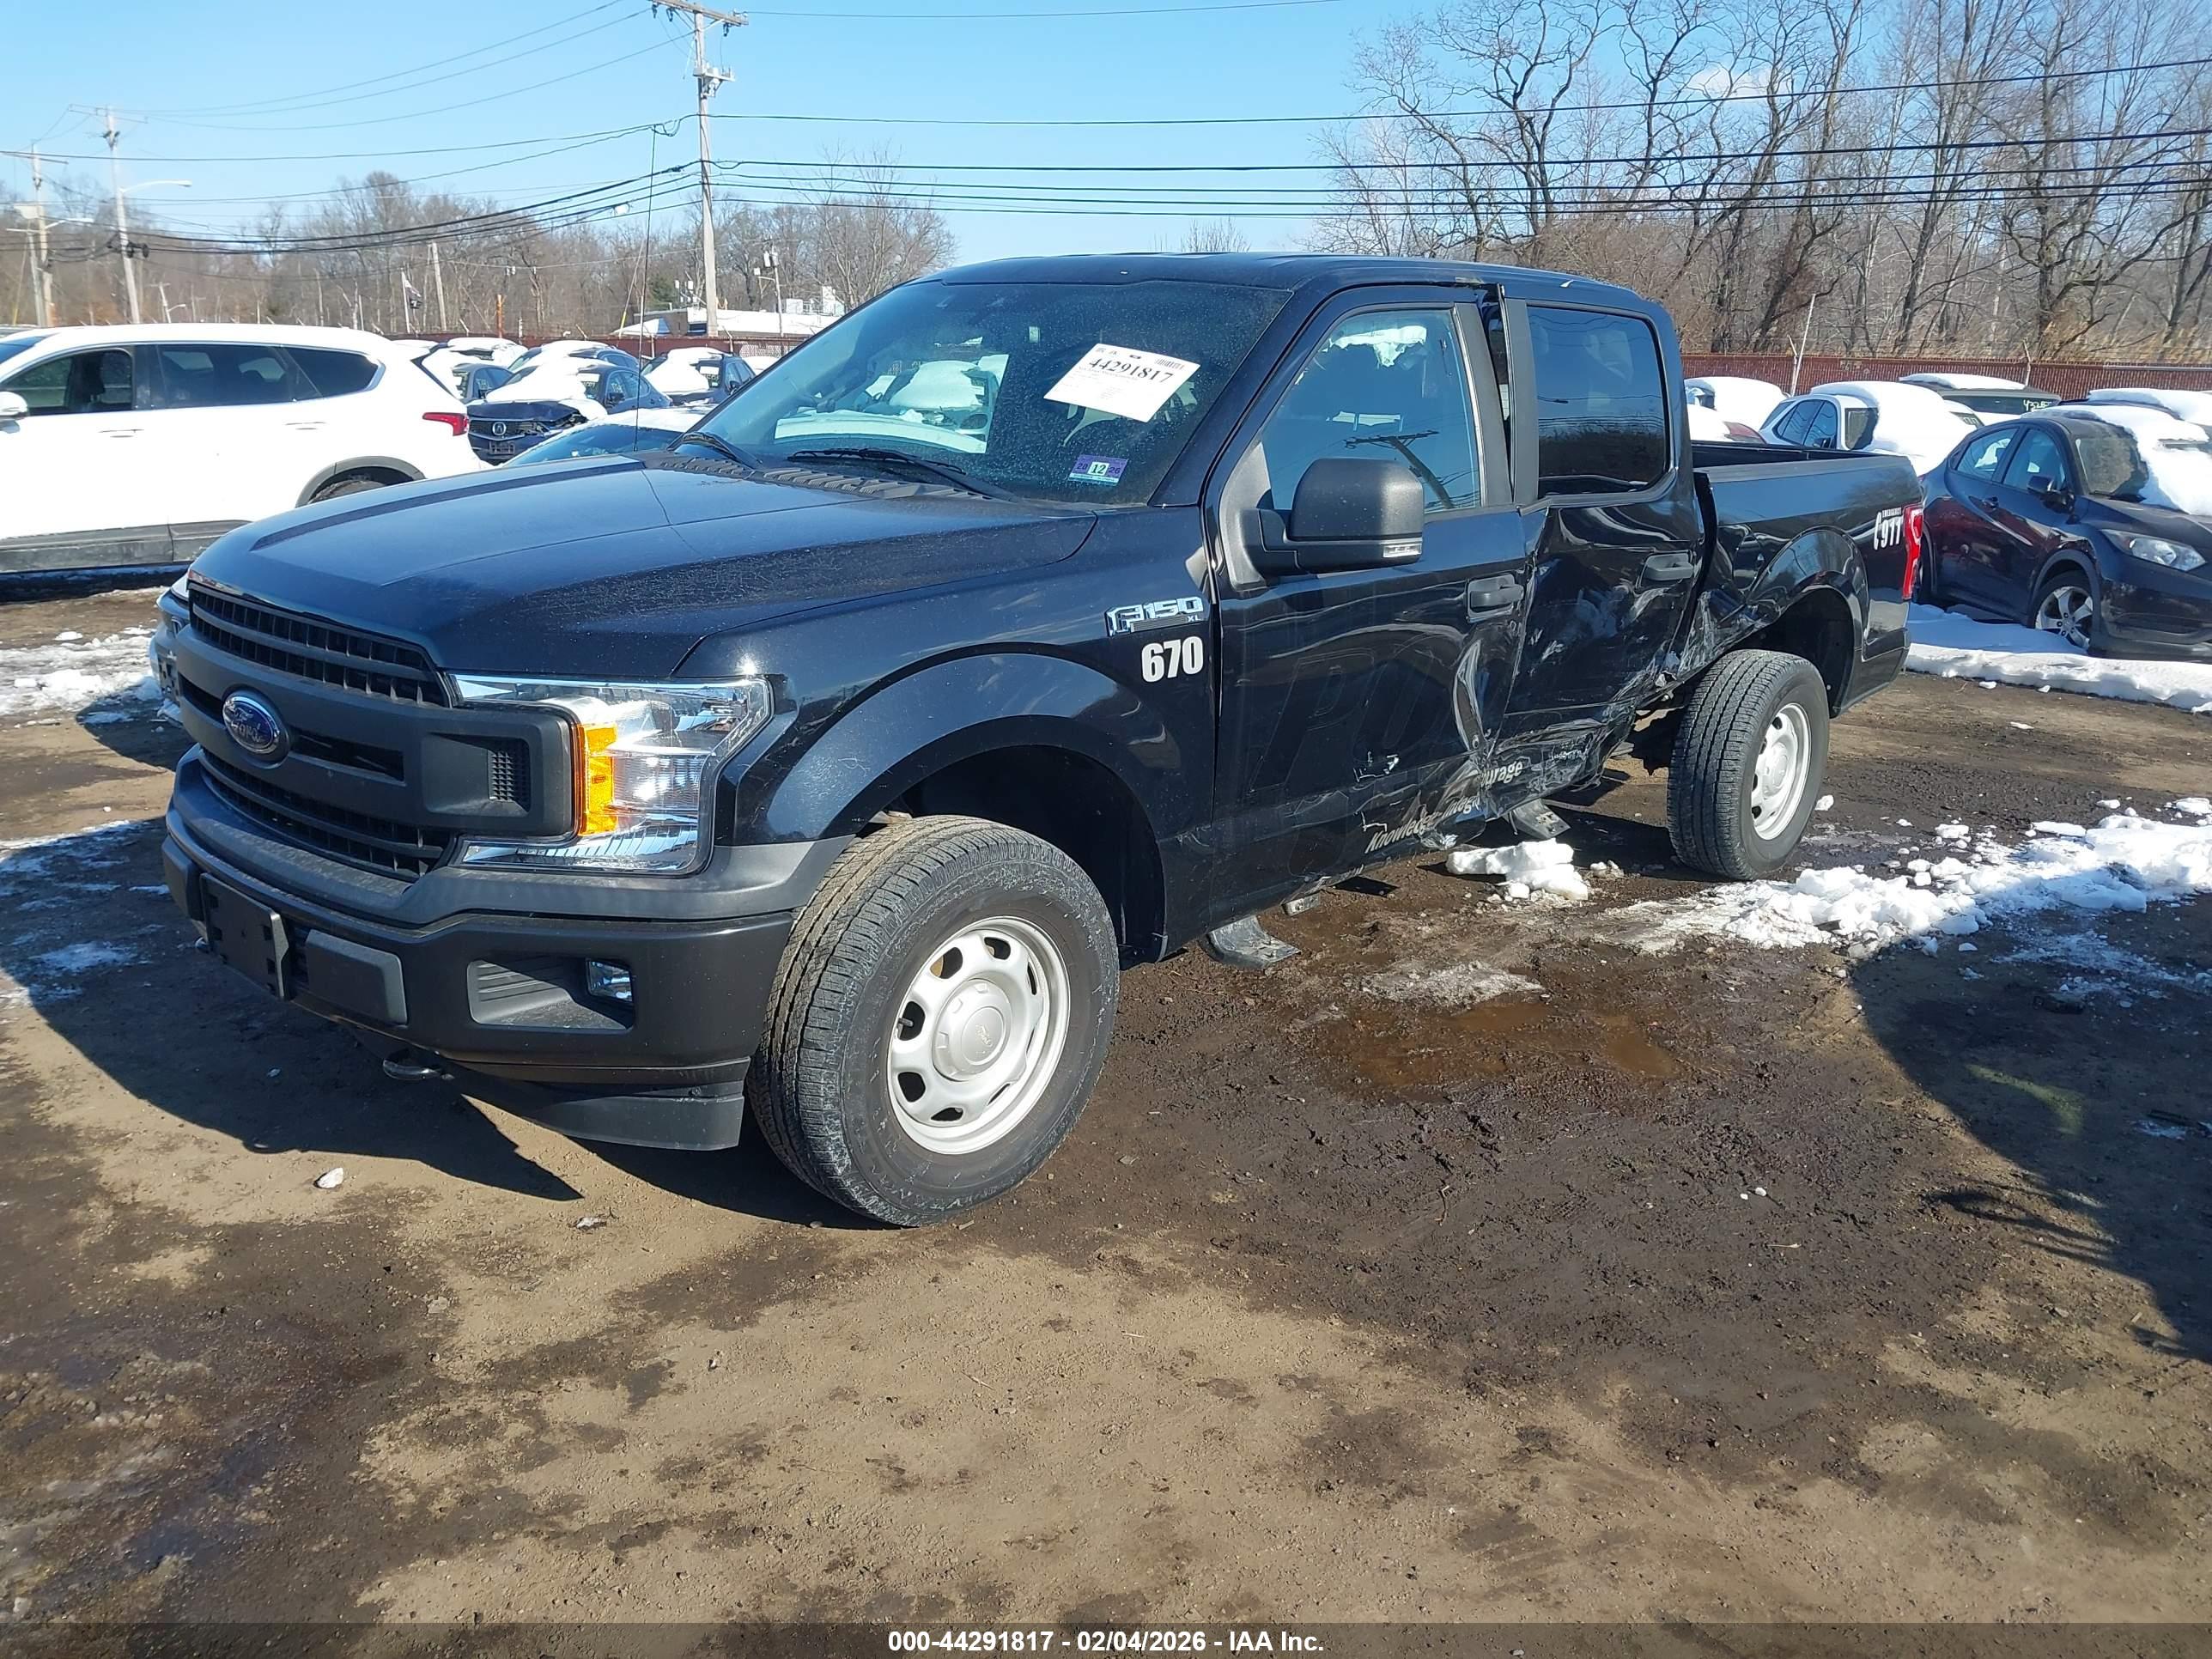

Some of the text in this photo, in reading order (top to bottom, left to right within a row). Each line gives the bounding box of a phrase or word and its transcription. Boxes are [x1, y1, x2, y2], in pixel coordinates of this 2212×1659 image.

[1088, 357, 1175, 384] 44291817
[1091, 464, 1106, 474] 12
[1881, 519, 1901, 548] 911
[1141, 635, 1204, 683] 670
